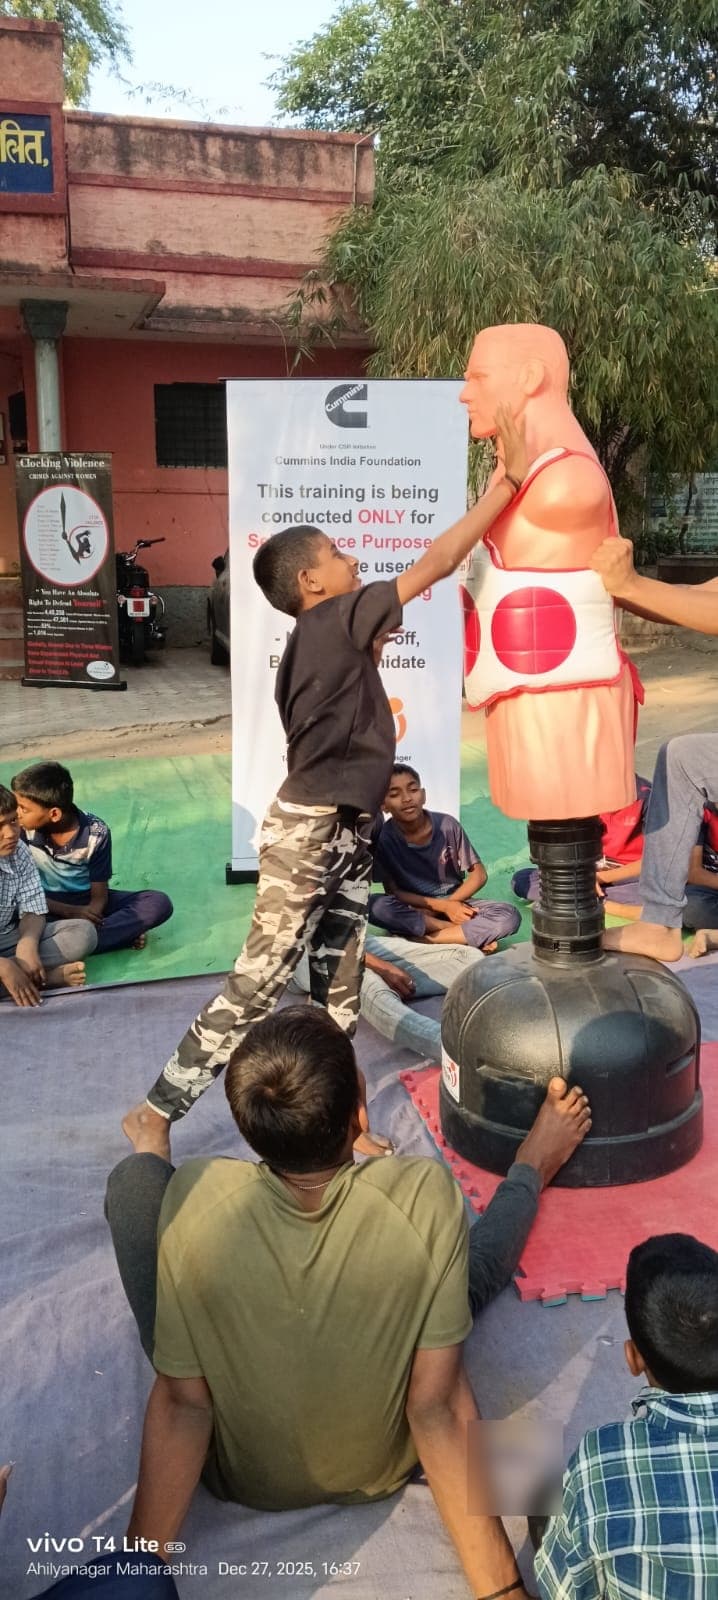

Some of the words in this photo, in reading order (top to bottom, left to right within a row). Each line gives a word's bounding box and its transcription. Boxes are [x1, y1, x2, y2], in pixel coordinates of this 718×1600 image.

[0, 120, 49, 167] लित,
[325, 384, 365, 412] Cummins
[20, 457, 61, 469] Clocking
[64, 457, 105, 468] Violence
[275, 456, 327, 467] Cummins
[330, 456, 356, 467] India
[360, 456, 421, 467] Foundation
[257, 484, 294, 499] This
[300, 484, 366, 502] training
[371, 484, 386, 499] is
[391, 484, 439, 502] being
[261, 509, 352, 524] conducted
[358, 509, 405, 524] ONLY
[410, 510, 435, 524] for
[362, 534, 433, 552] Purpose
